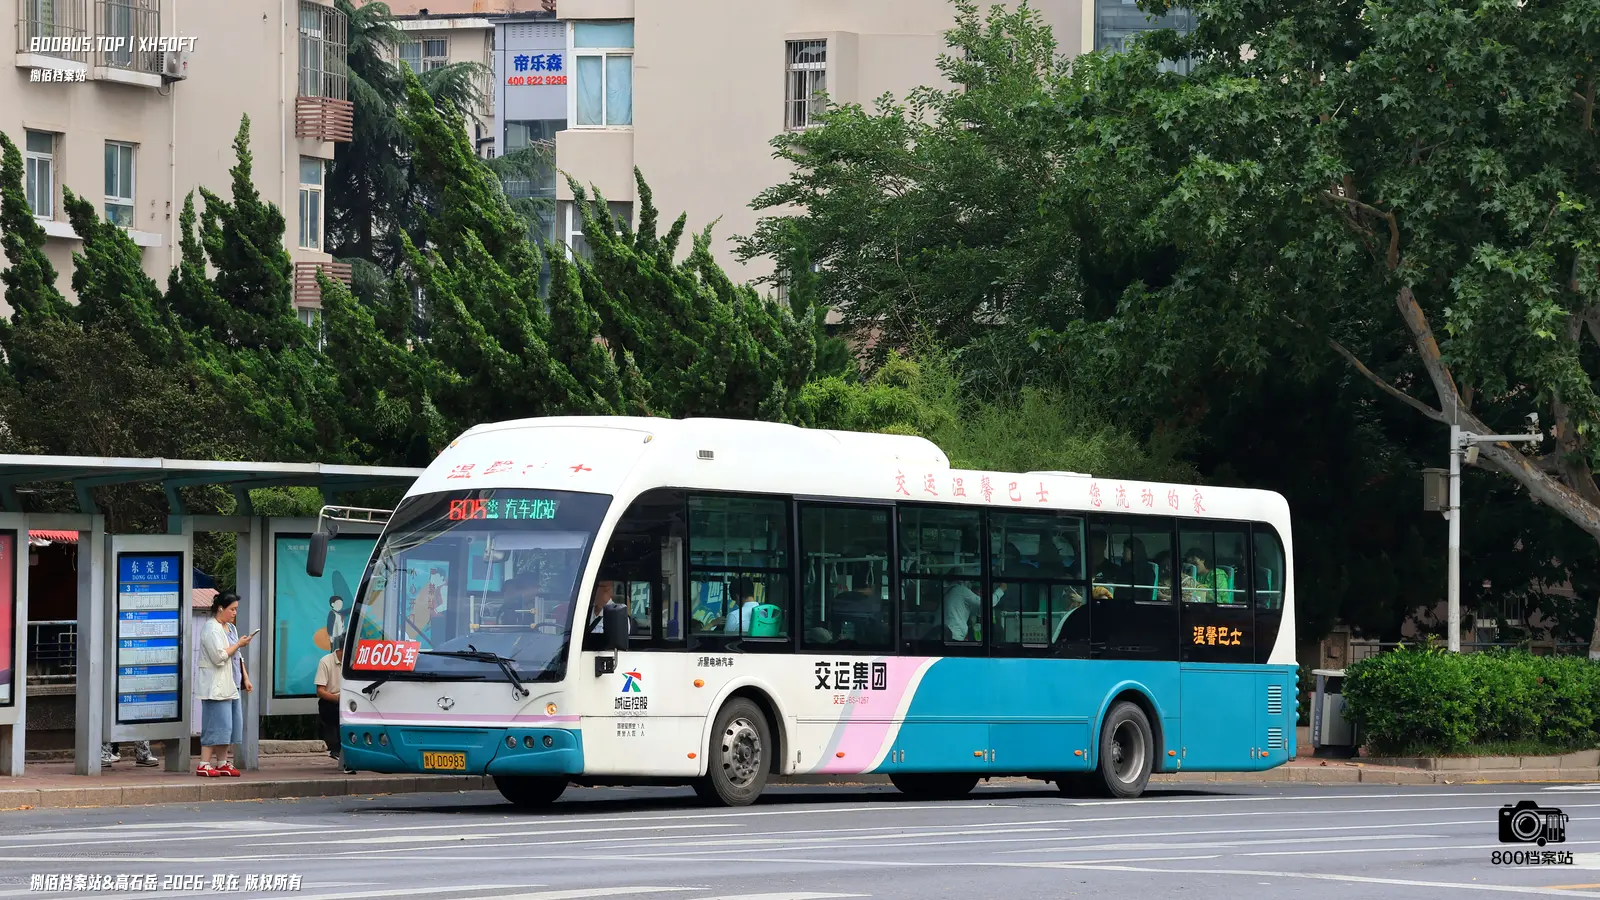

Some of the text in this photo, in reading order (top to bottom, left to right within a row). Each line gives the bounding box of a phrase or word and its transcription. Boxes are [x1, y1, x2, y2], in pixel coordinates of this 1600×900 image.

[513, 53, 563, 72] 帝乐森
[507, 75, 567, 86] 400 822 9296
[895, 468, 1206, 515] 交运温馨巴士 您流动的家
[448, 498, 557, 521] 605 汽车北站
[131, 560, 169, 574] 东莞路
[126, 584, 131, 592] 3
[1193, 625, 1243, 646] 温馨巴士
[356, 643, 417, 667] 加605车
[697, 656, 734, 667] 沂星电动汽车
[815, 661, 887, 690] 交运集团
[614, 696, 648, 710] 城运控股
